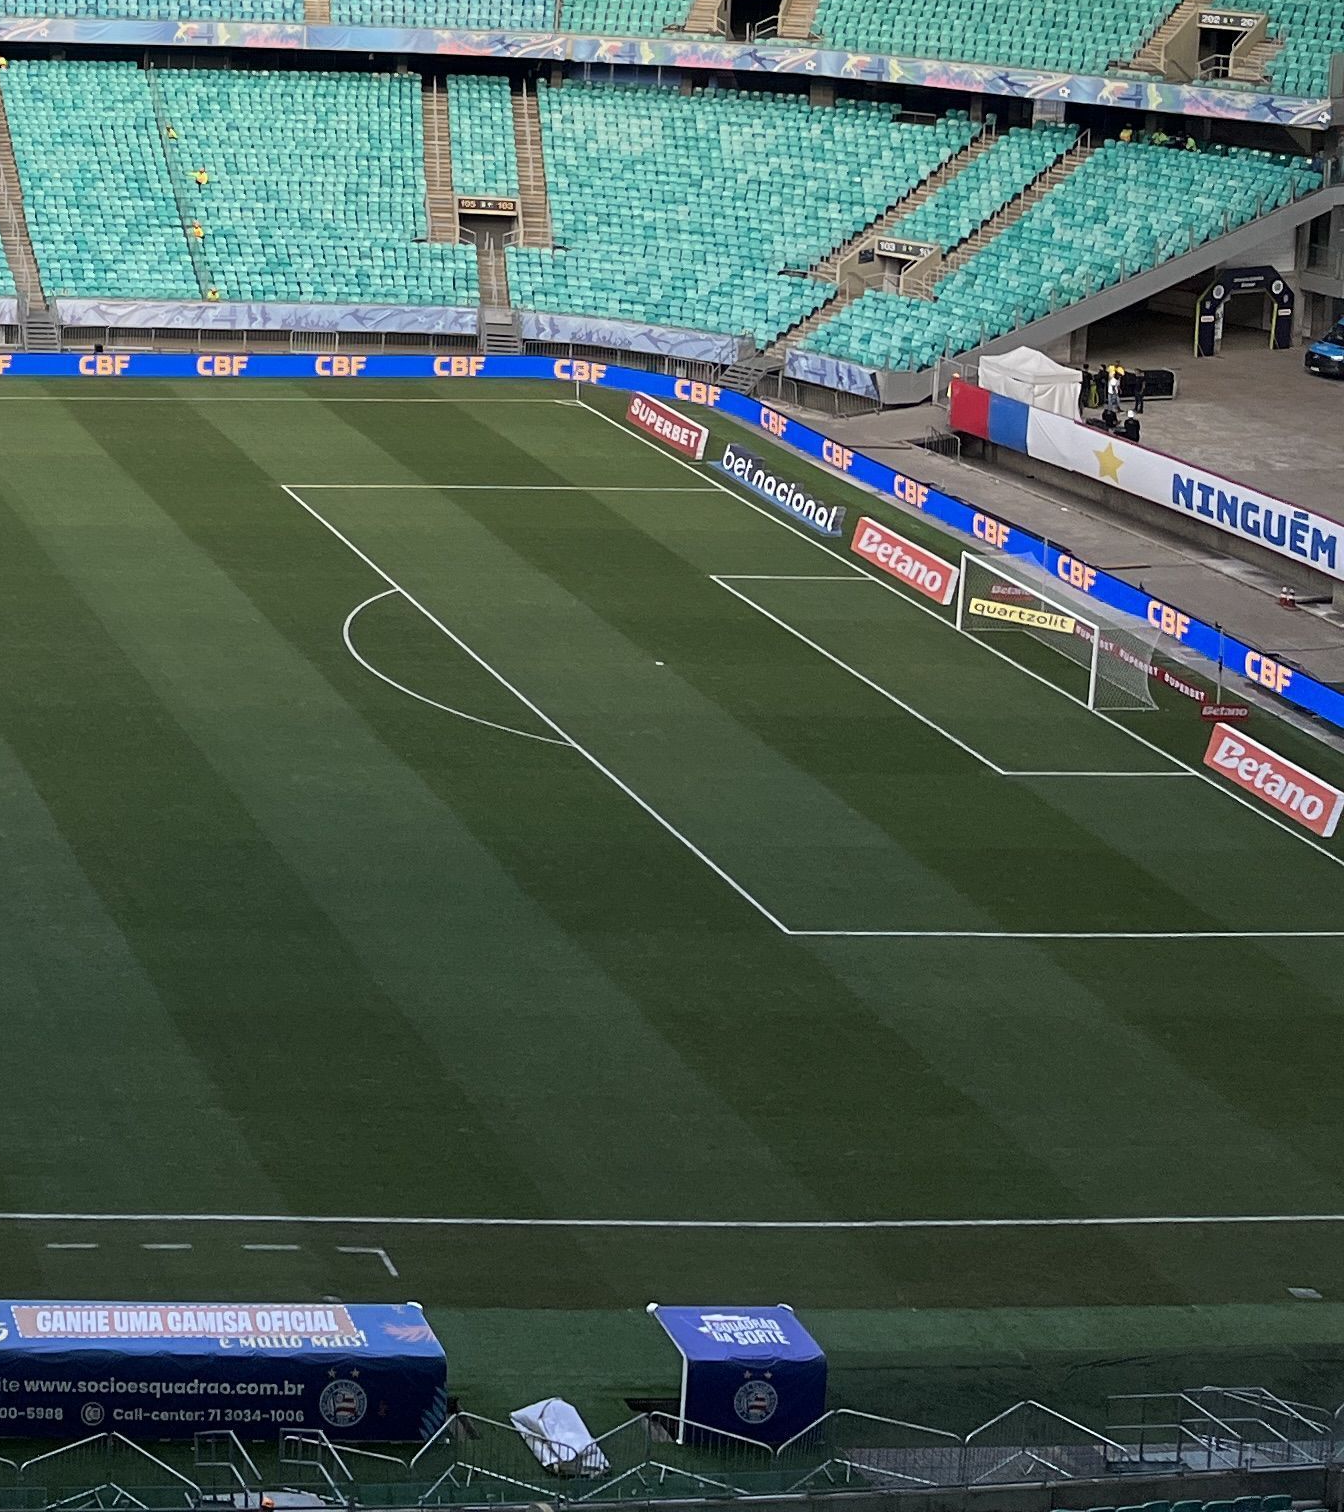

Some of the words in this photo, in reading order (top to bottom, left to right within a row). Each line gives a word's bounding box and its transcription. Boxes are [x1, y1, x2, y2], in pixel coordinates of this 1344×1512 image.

[1201, 14, 1221, 25] 202
[879, 241, 896, 252] 103
[79, 354, 130, 376] CBF
[196, 355, 248, 376] CBF
[315, 355, 366, 377] CBF
[433, 356, 485, 377] CBF
[553, 358, 607, 384] CBF
[674, 379, 721, 407] CBF
[630, 397, 700, 449] SUPERBET
[759, 407, 788, 437] CBF
[822, 438, 853, 471] CBF
[894, 474, 929, 509] CBF
[972, 512, 1011, 548] CBF
[1171, 472, 1337, 570] NINGUÉM
[857, 527, 943, 593] Betano
[1057, 554, 1097, 591] CBF
[973, 601, 1069, 629] quartzolit
[1147, 600, 1190, 640] CBF
[1244, 651, 1293, 693] CBF
[1164, 672, 1205, 702] SUPERBET
[1202, 705, 1249, 717] Betano
[1212, 736, 1324, 822] Betano
[36, 1311, 110, 1334] GANHE
[113, 1311, 163, 1334] UMA
[167, 1310, 254, 1333] CAMISA
[255, 1310, 339, 1333] OFICIAL
[711, 1330, 736, 1343] DA
[733, 1328, 791, 1345] SORTE
[24, 1377, 305, 1399] www.socioesquadrao.com.br
[112, 1407, 205, 1422] Call-center:
[208, 1408, 221, 1421] 71
[224, 1408, 305, 1423] 3034-1006
